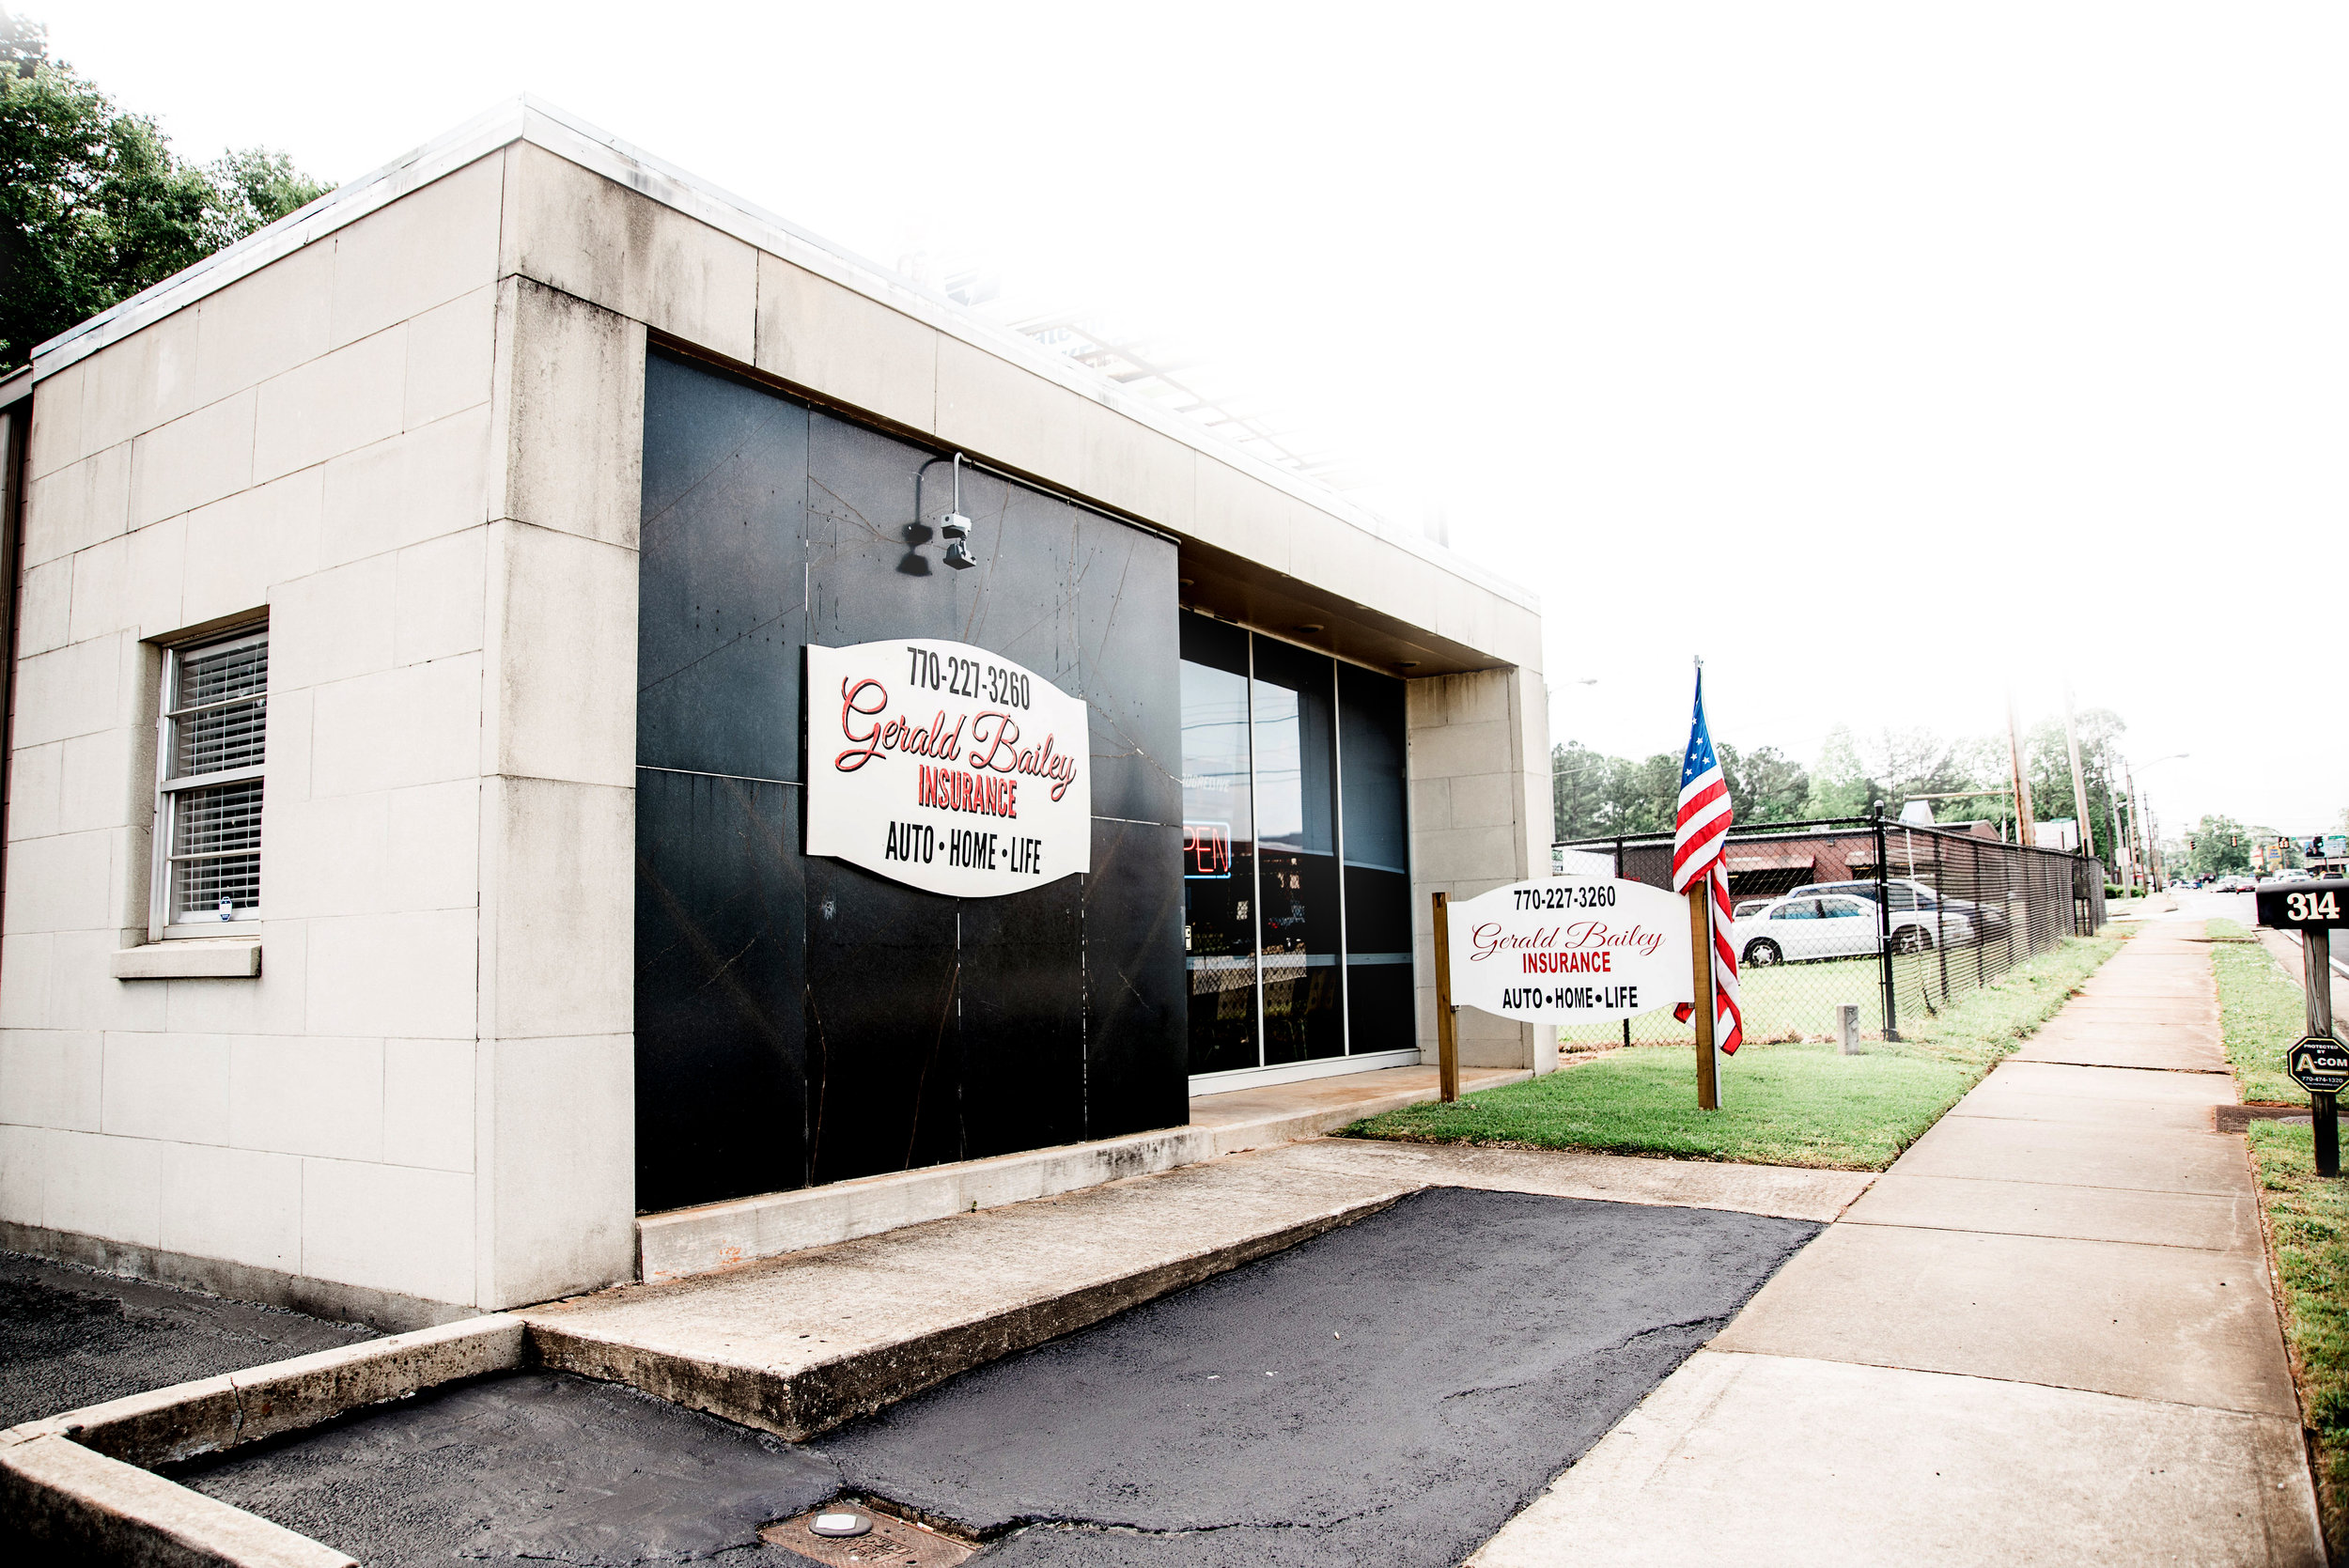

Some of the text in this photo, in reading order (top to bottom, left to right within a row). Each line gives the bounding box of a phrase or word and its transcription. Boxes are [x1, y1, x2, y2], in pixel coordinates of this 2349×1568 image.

[908, 646, 1031, 710] 770-227-3260
[835, 675, 1077, 802] Gerald Bailey
[918, 764, 1018, 819] INSURANCE
[885, 821, 1042, 874] AUTO HOME LIFE
[1183, 826, 1228, 872] PEN
[1514, 885, 1616, 910] 770-227-3260
[2287, 892, 2341, 922] 314
[1470, 921, 1666, 961] Gerald Bailey
[1522, 951, 1611, 973] INSURANCE
[1501, 986, 1639, 1009] AUTO HOME LIFE
